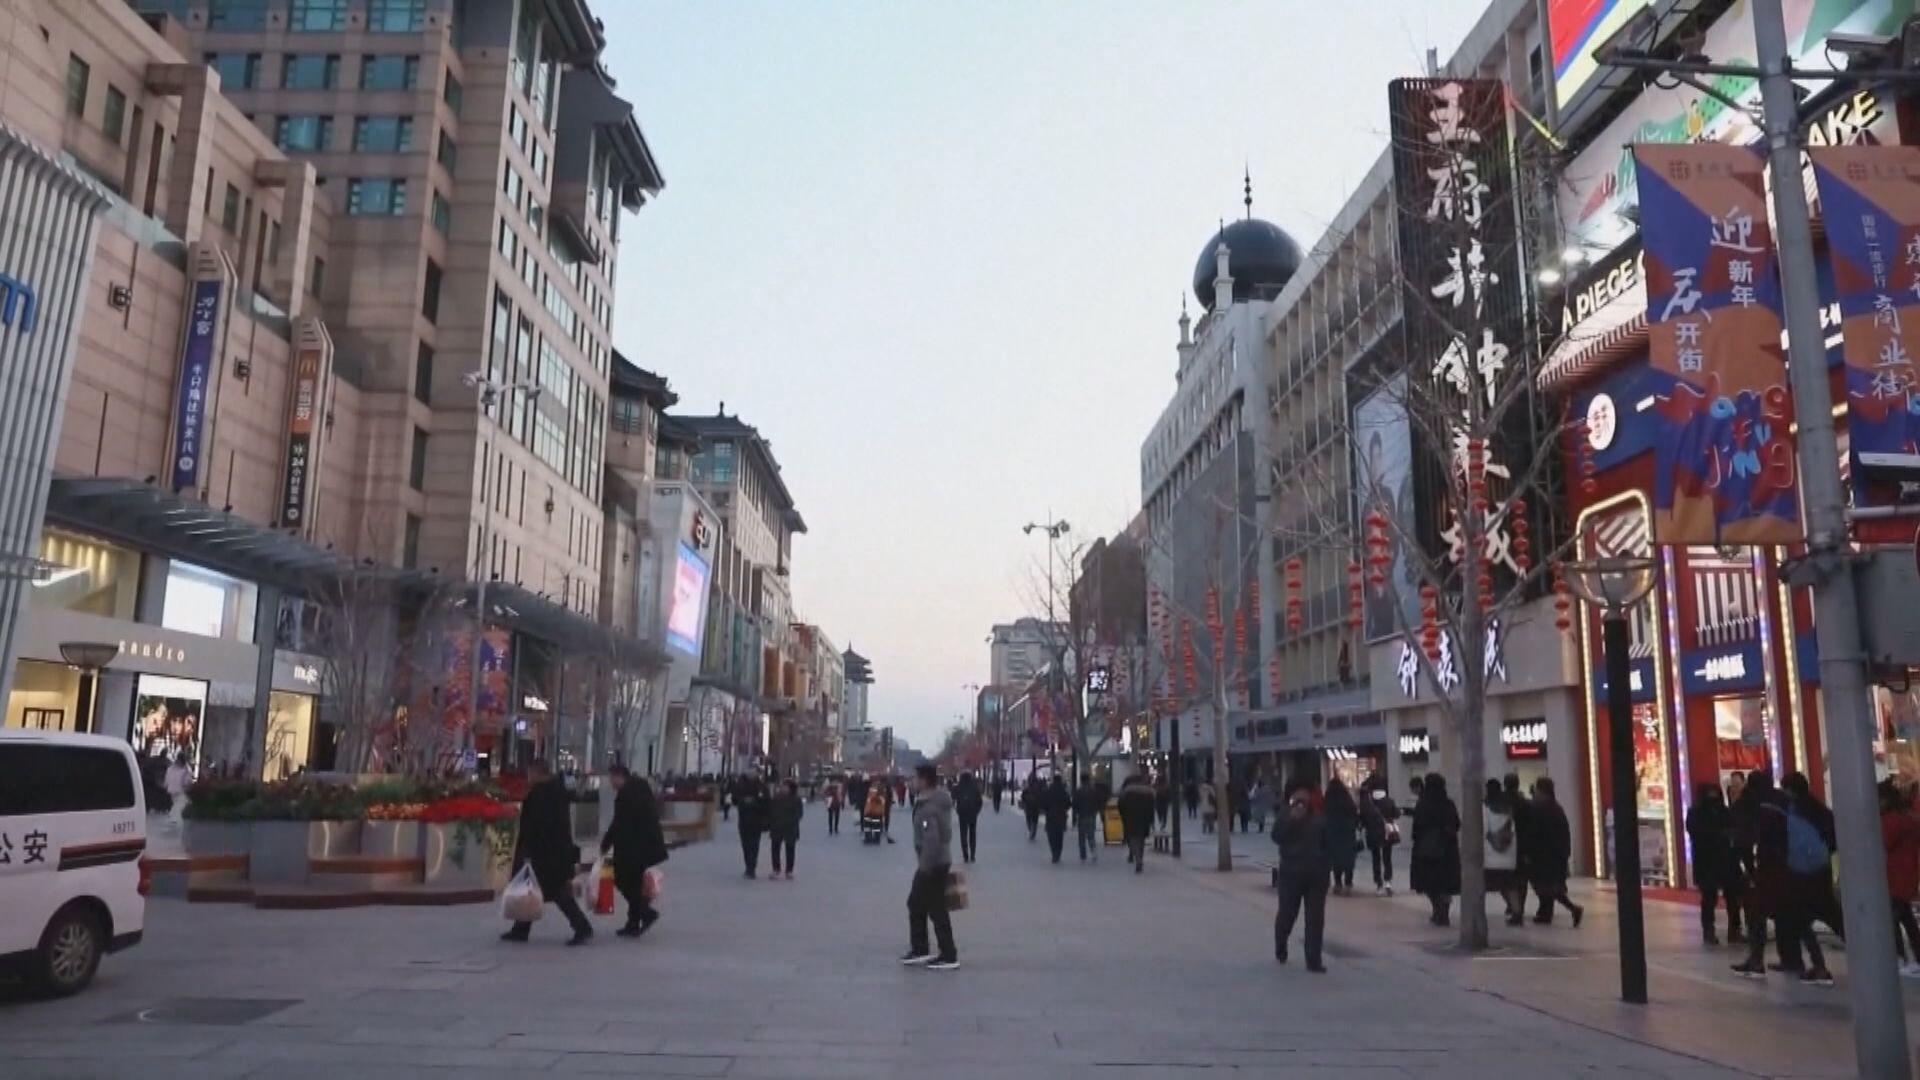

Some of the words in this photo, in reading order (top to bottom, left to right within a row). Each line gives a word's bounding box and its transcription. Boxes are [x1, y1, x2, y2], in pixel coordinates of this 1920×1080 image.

[1562, 305, 1573, 336] A
[1576, 259, 1634, 322] PIECE
[1808, 90, 1876, 146] AKE
[1710, 205, 1765, 308] 迎新年
[118, 638, 185, 662] sandro
[0, 829, 48, 865] 公安
